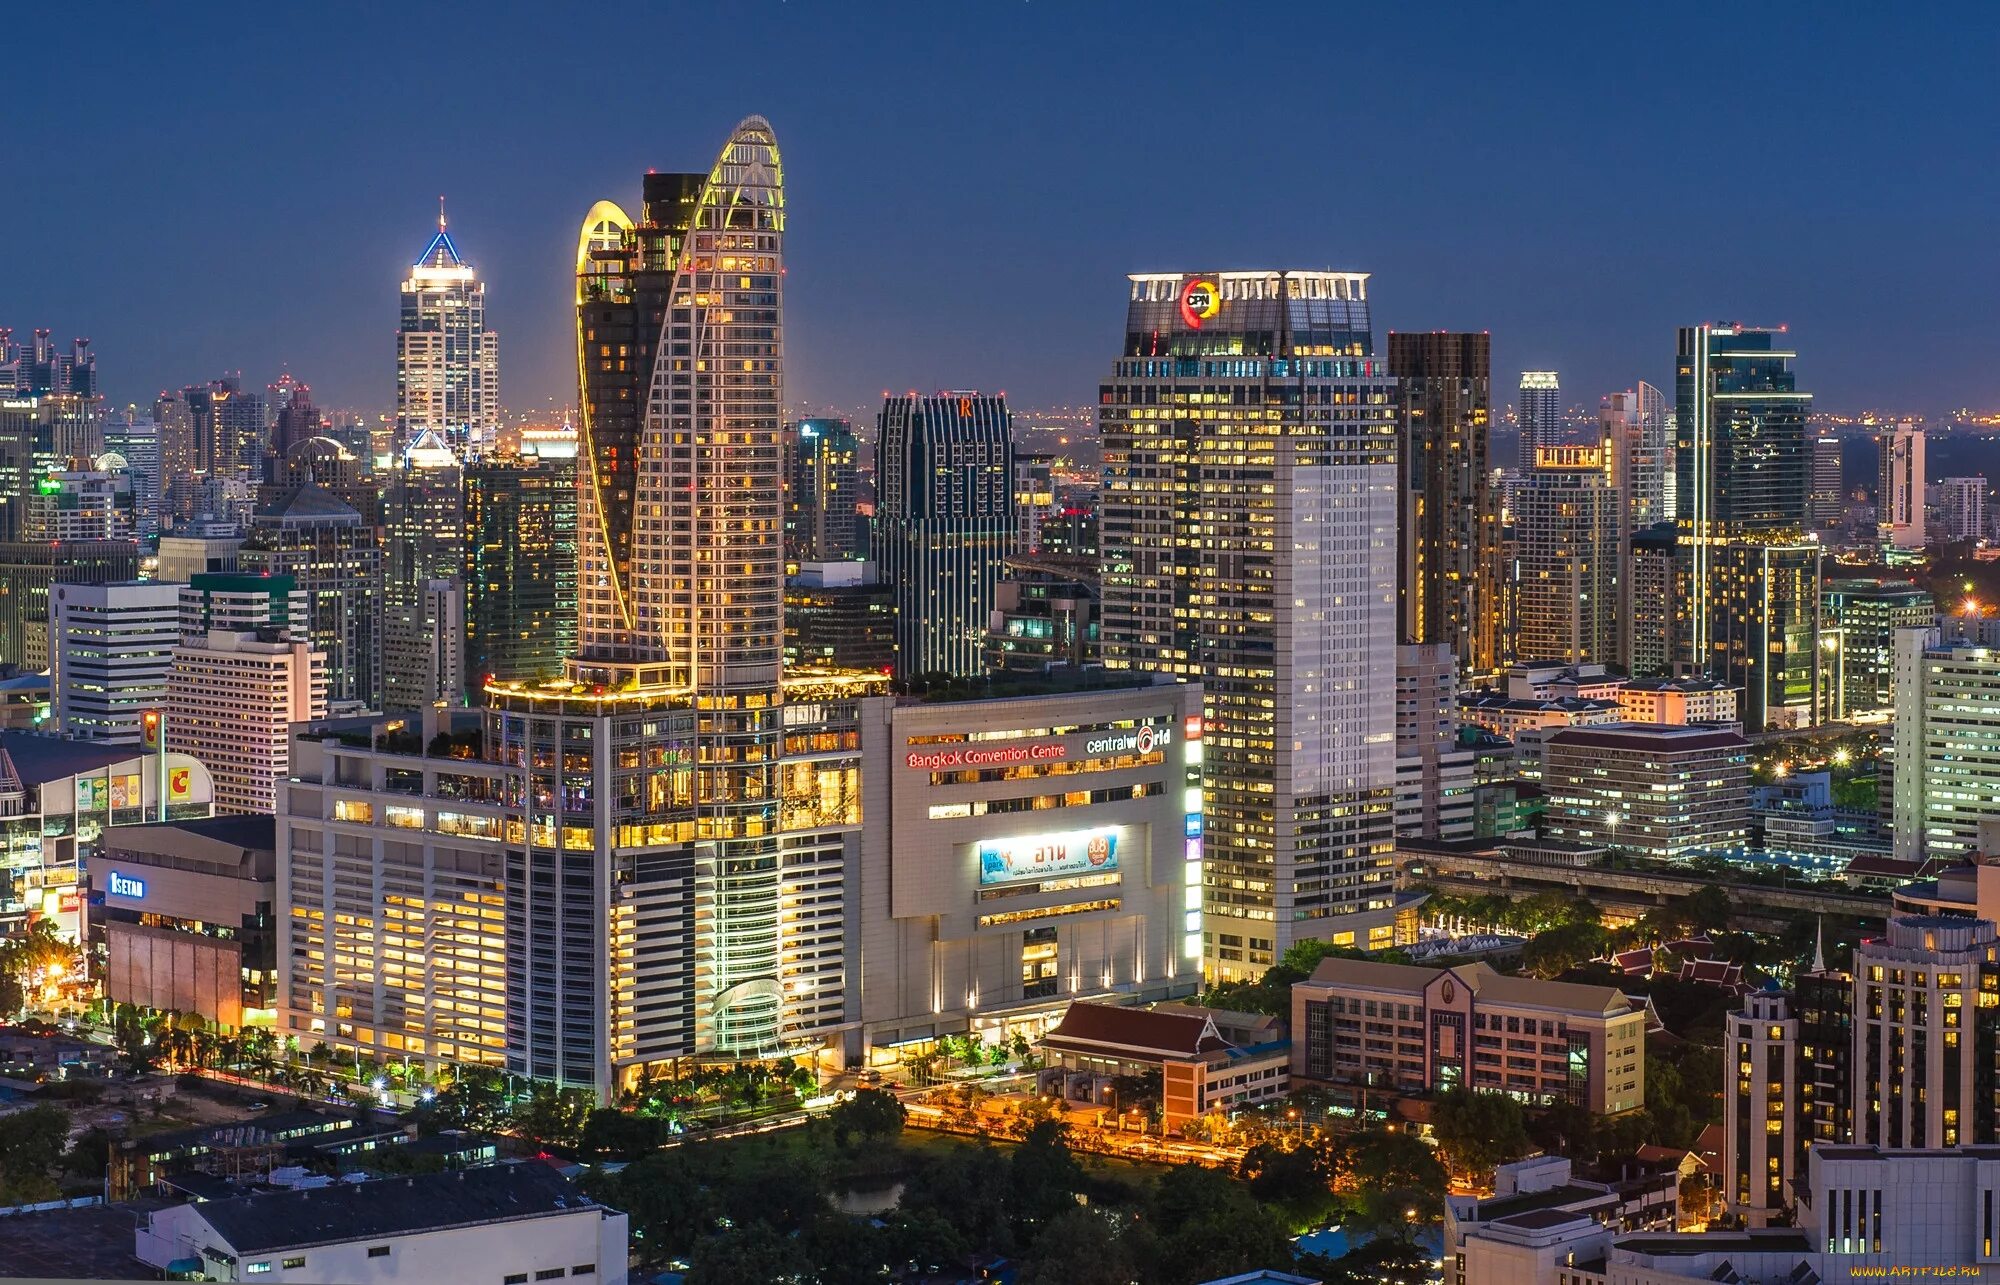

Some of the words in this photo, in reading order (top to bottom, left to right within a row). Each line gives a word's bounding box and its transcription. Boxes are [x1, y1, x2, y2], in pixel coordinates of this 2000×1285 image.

[1187, 295, 1209, 305] CPN
[960, 398, 972, 417] R
[908, 751, 962, 769] Bangkok
[965, 748, 1028, 764] Convention
[1031, 745, 1065, 758] Centre
[988, 853, 998, 861] TK
